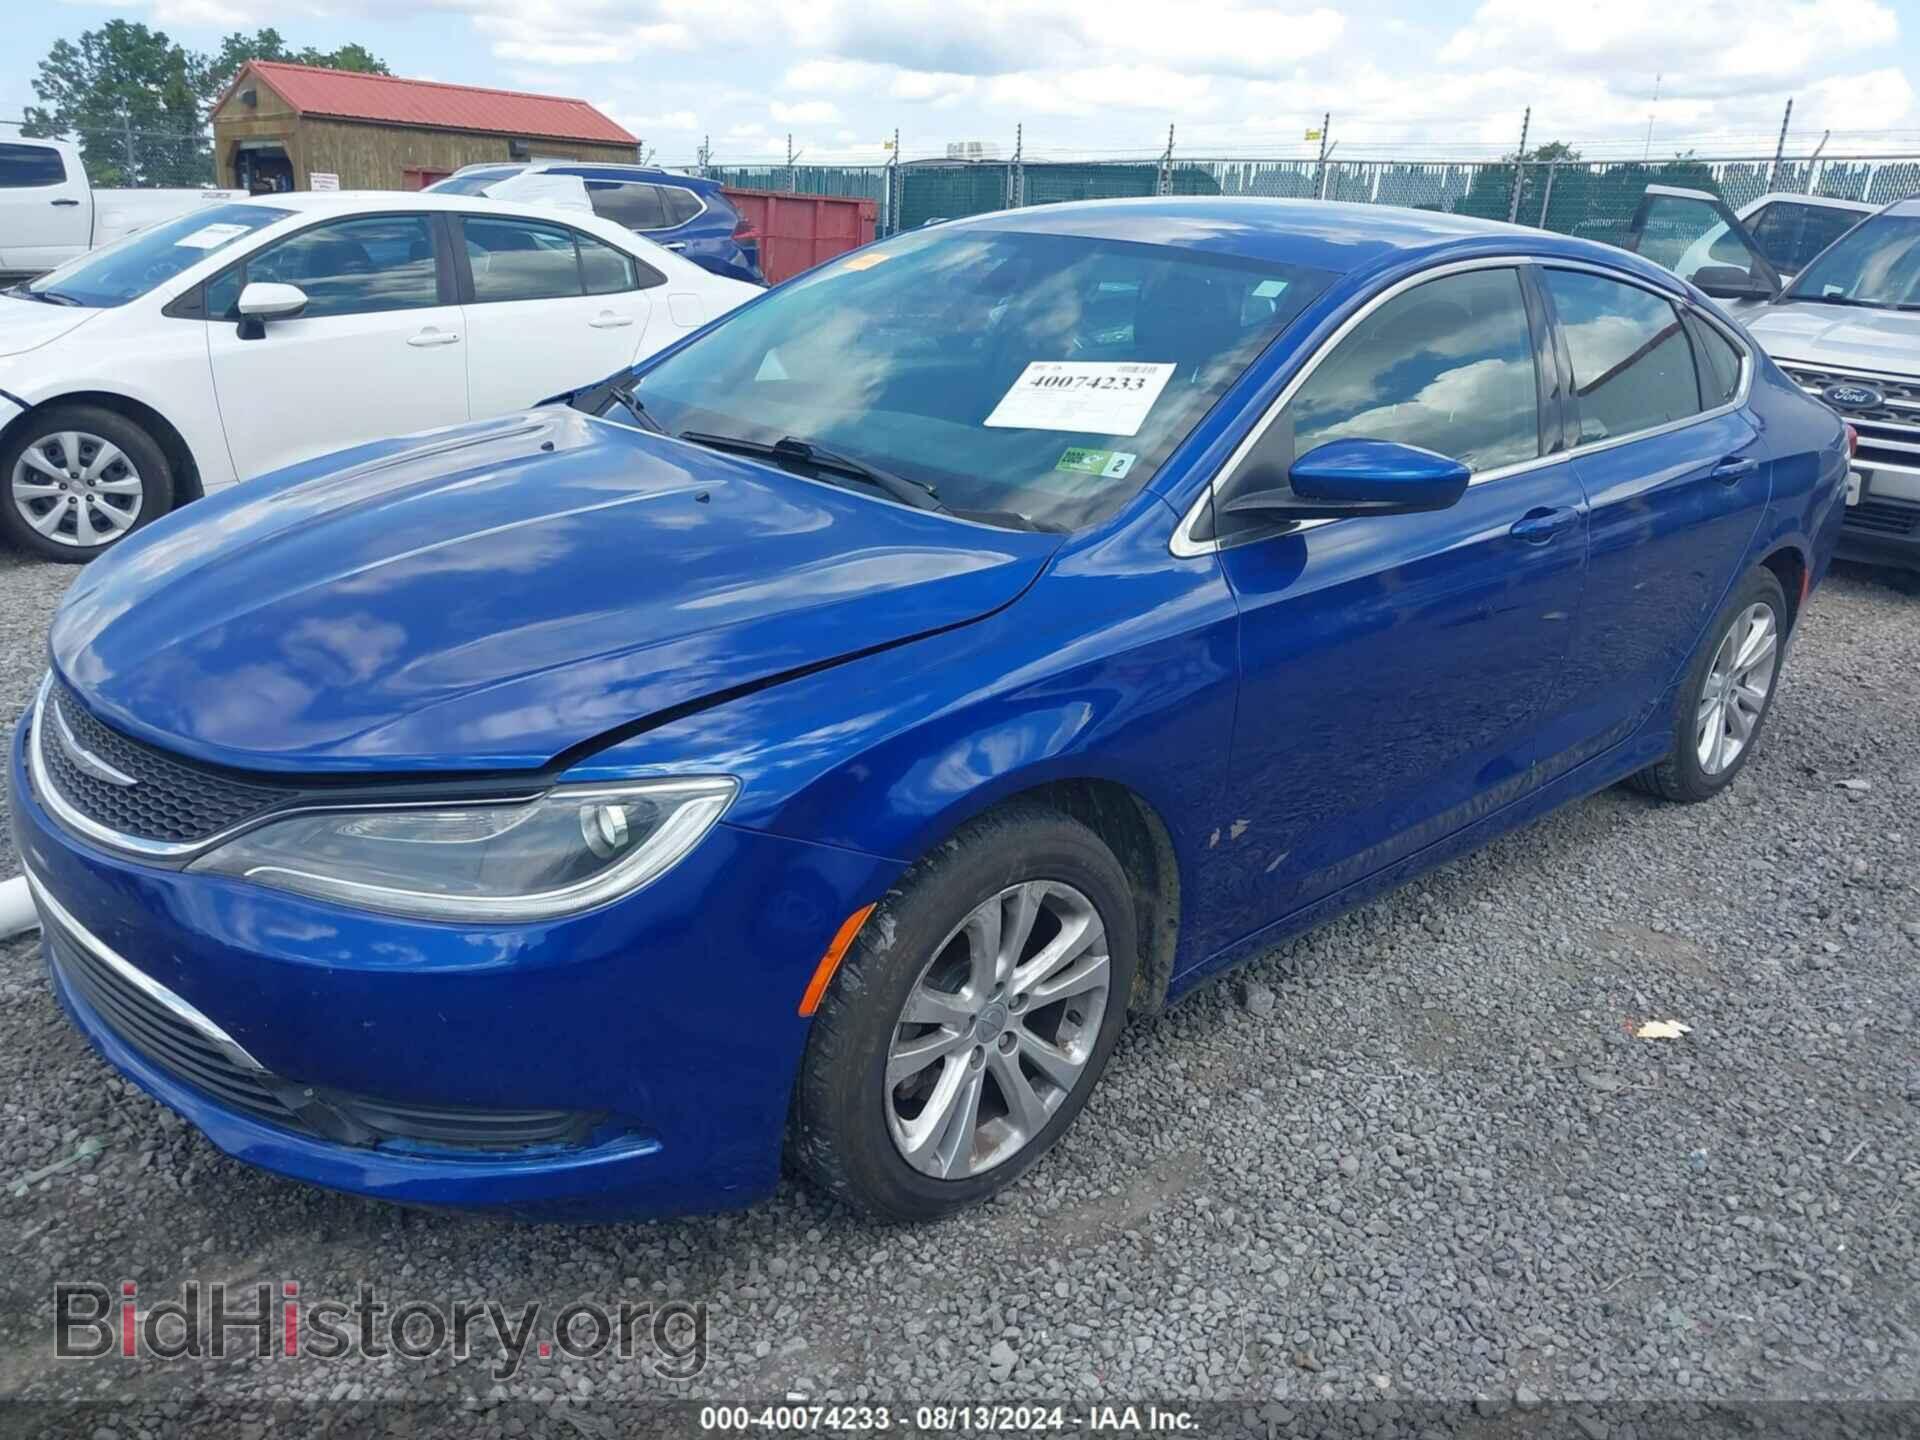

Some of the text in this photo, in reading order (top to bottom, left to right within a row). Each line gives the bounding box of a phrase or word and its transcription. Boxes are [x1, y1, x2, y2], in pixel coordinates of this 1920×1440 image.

[1031, 375, 1146, 391] 40074233
[1834, 388, 1867, 402] Ford
[1112, 459, 1125, 472] 2
